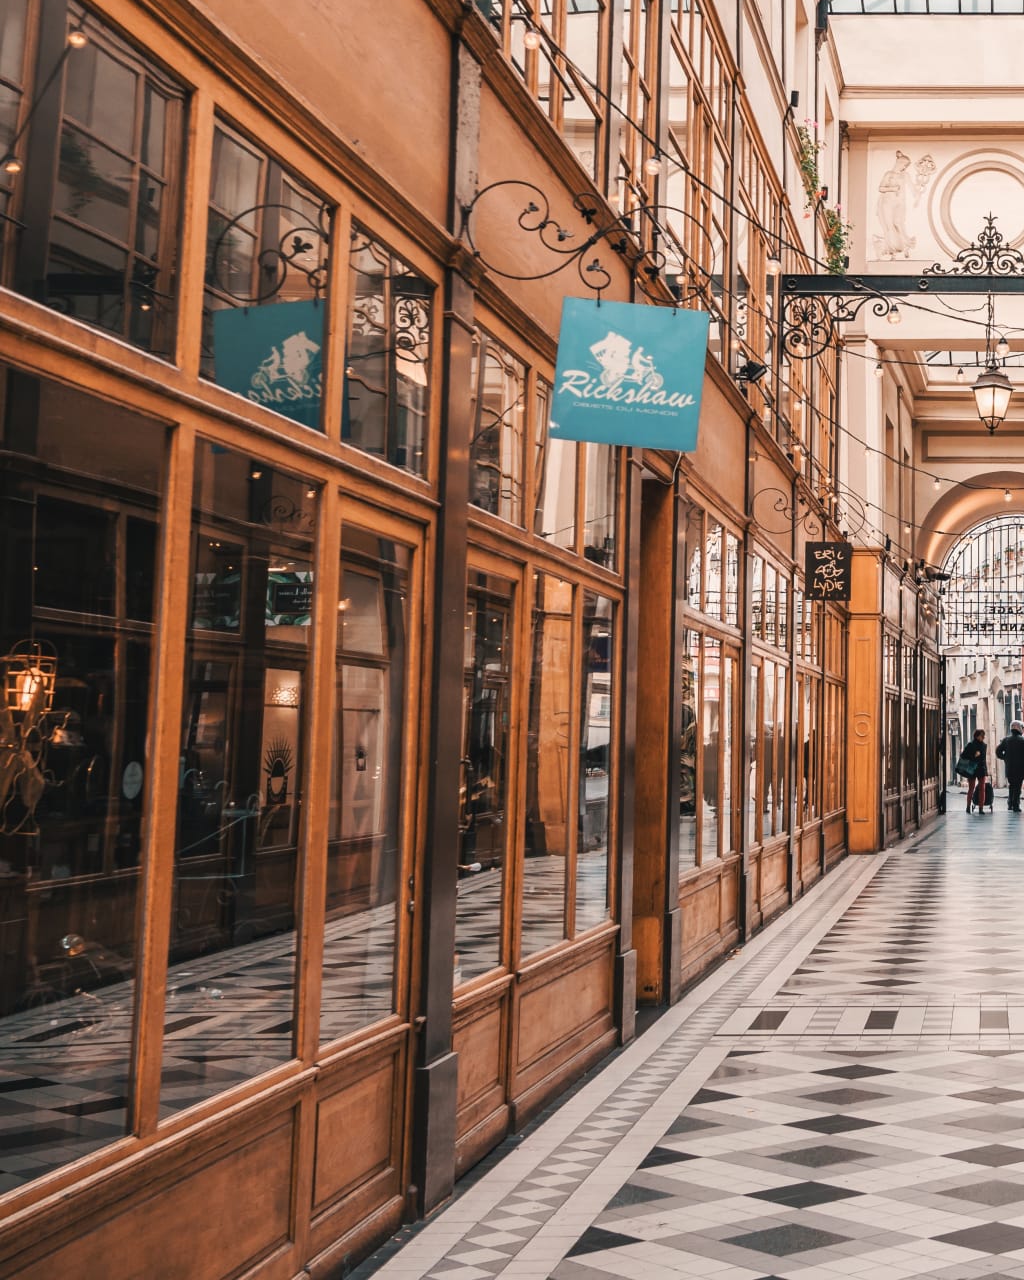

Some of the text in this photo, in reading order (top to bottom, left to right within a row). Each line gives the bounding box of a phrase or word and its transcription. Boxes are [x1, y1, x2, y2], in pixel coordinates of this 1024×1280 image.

[558, 369, 696, 408] Rickshaw
[615, 405, 633, 413] DU
[636, 407, 679, 417] MONDE
